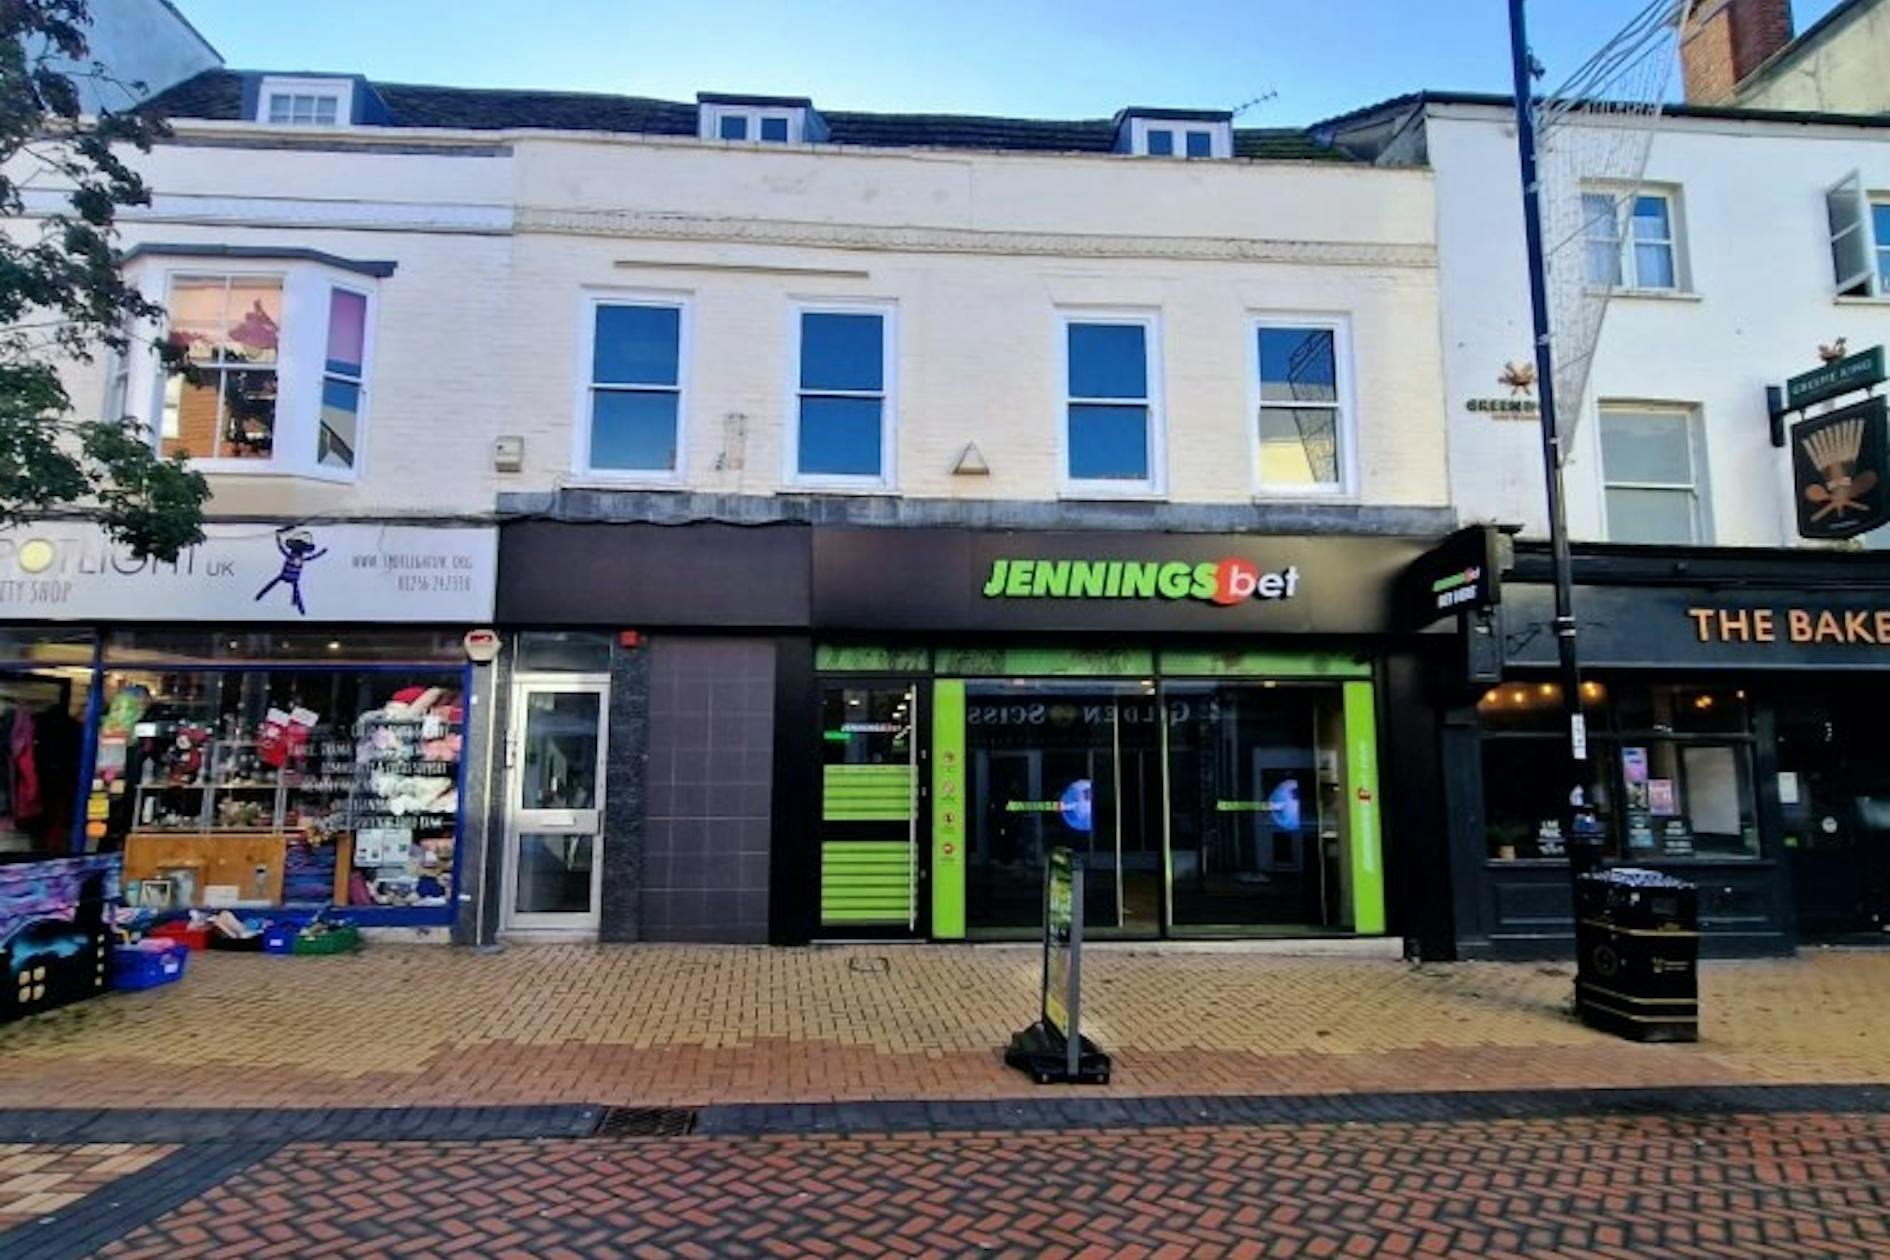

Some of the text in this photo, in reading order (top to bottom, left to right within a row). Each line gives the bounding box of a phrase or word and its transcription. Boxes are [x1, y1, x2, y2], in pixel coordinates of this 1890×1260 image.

[206, 561, 235, 577] UK
[1688, 608, 1890, 645] THE BAKE
